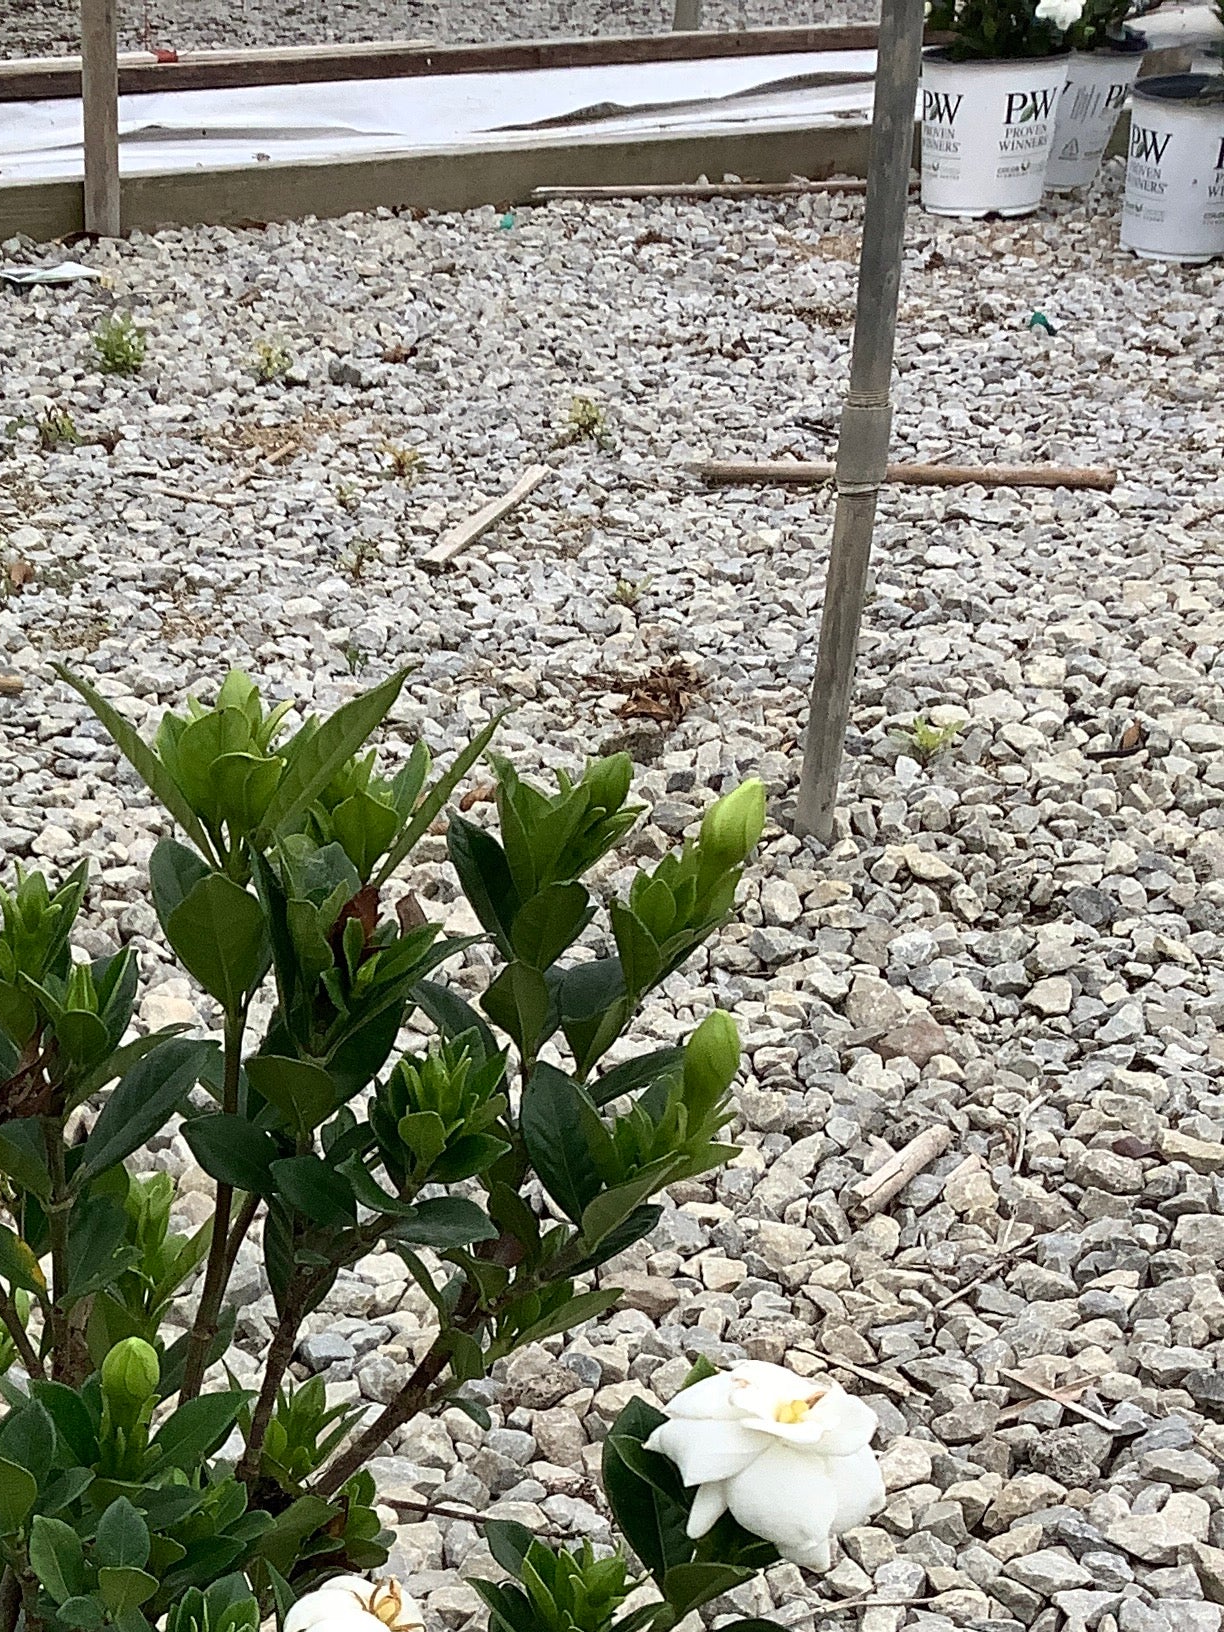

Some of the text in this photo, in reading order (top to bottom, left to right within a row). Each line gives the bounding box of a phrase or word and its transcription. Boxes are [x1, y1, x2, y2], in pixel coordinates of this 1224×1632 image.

[922, 88, 964, 126] PW
[1002, 86, 1058, 125] PW
[1130, 122, 1174, 166] PW
